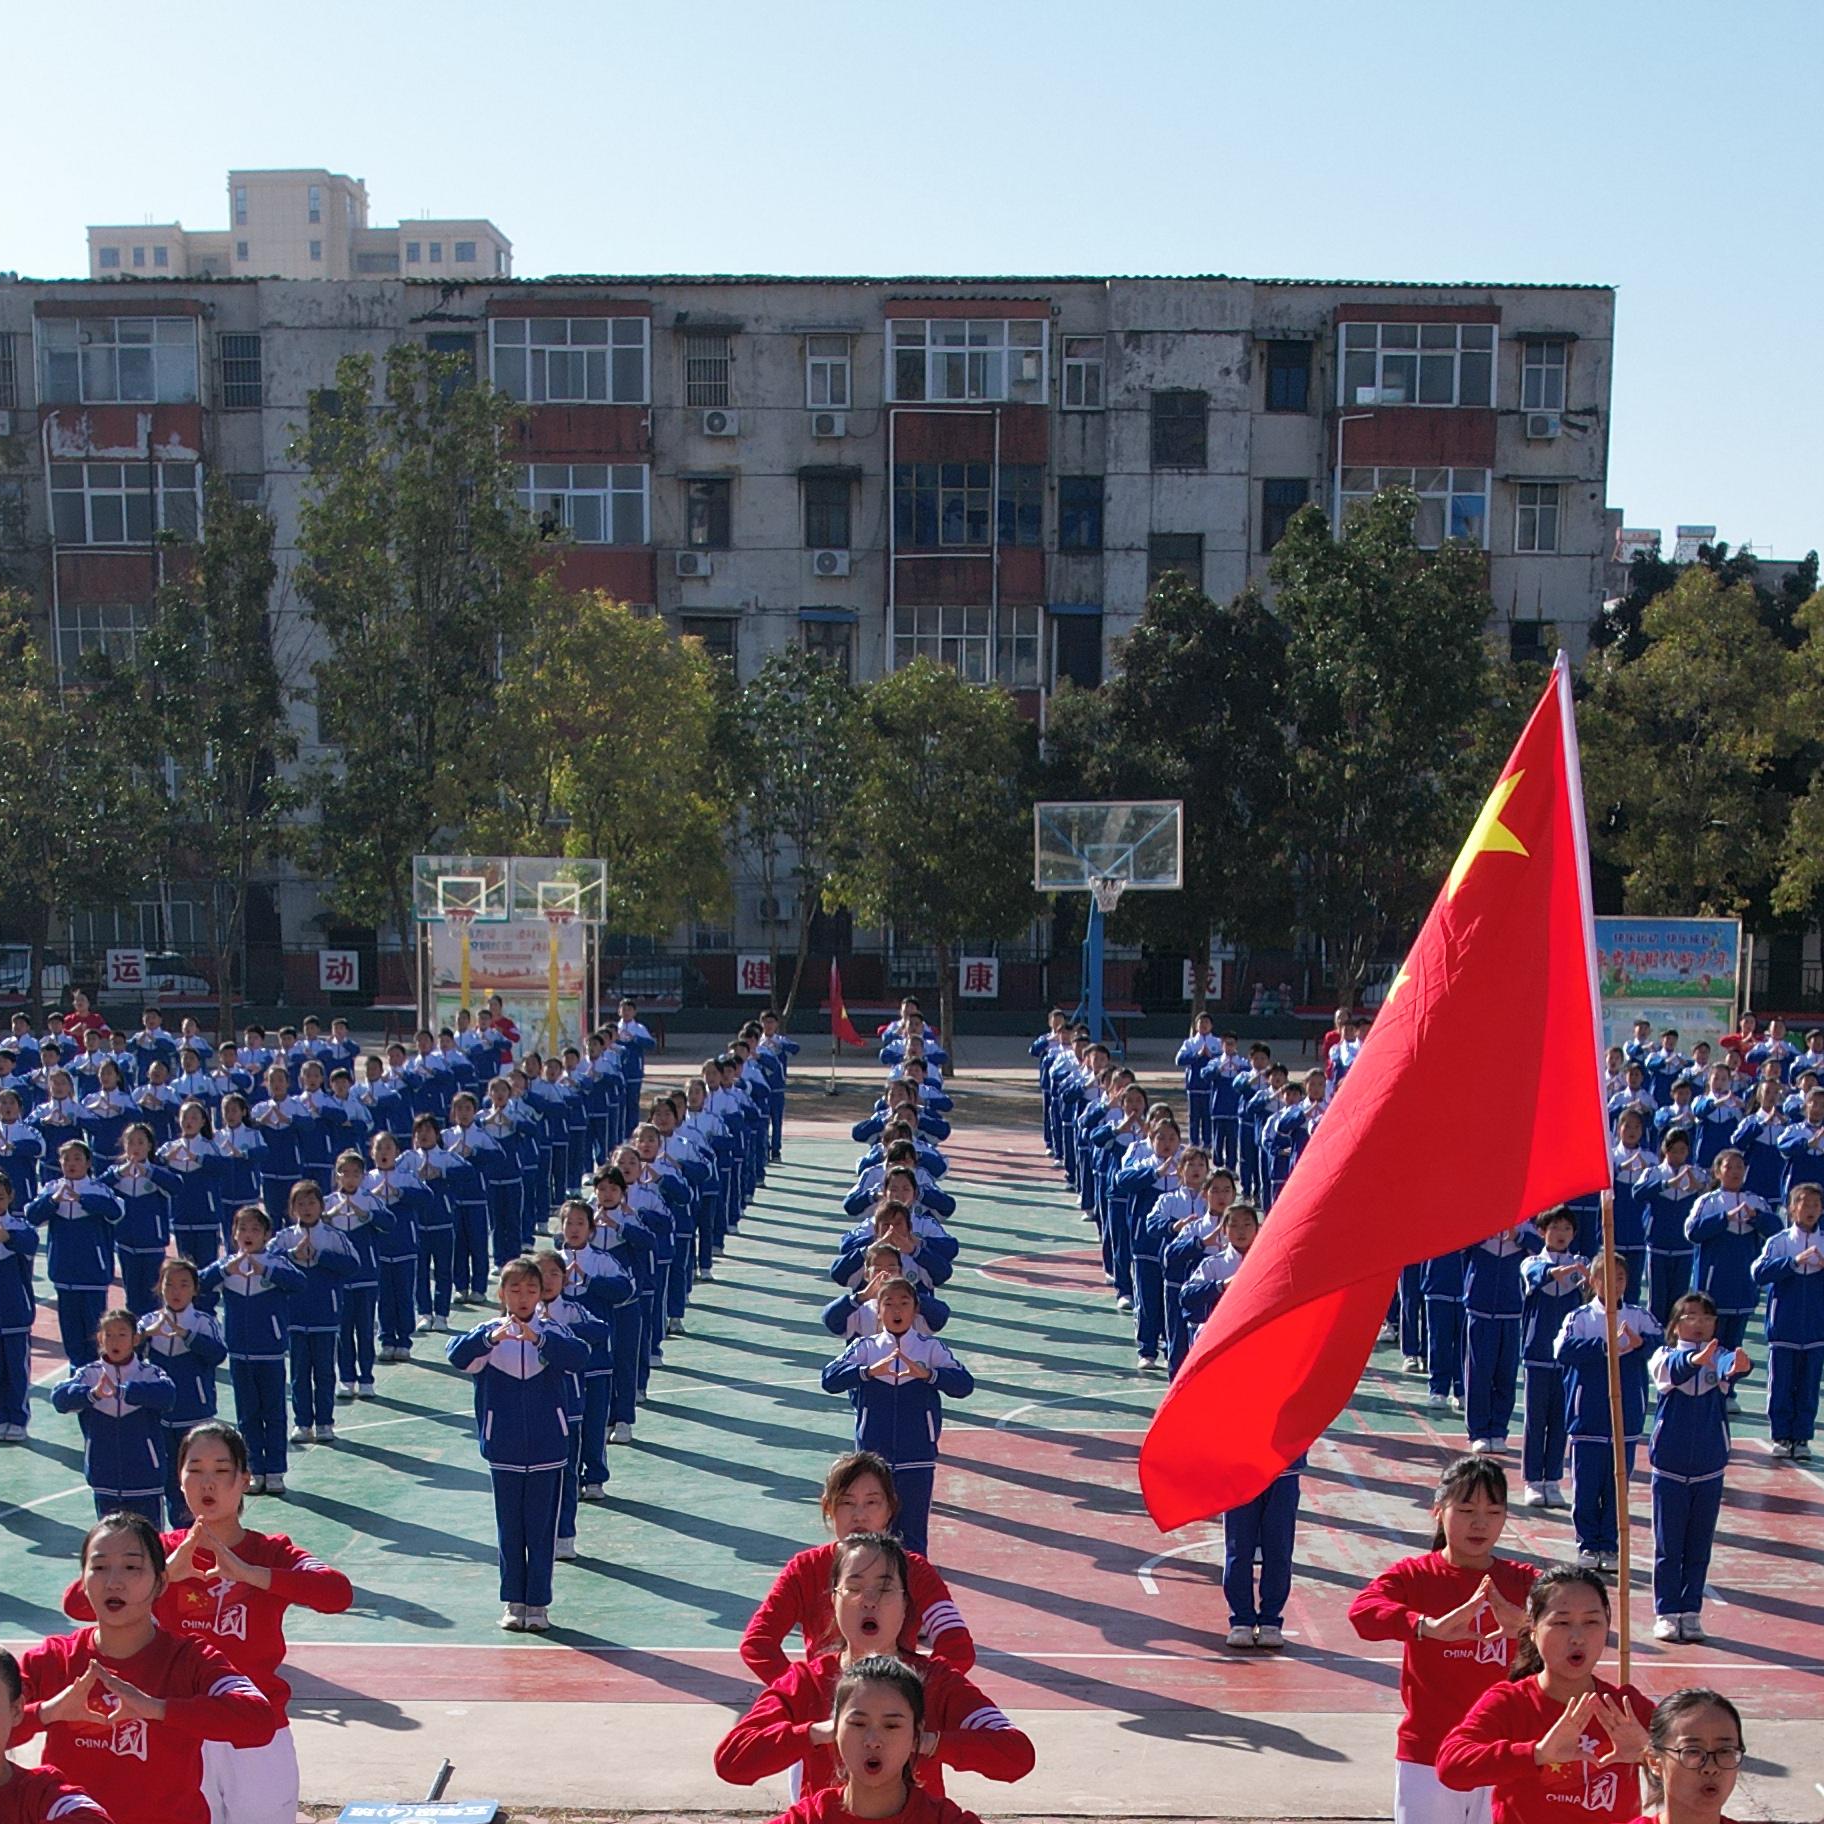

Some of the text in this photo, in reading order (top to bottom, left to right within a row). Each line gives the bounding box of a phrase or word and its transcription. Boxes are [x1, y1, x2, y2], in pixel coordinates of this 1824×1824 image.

[112, 954, 143, 983] 运
[325, 956, 355, 985] 动
[964, 963, 994, 992] 康
[181, 1620, 212, 1630] CHINA
[1443, 1649, 1474, 1659] CHINA
[75, 1738, 110, 1749] CHINA
[1545, 1793, 1581, 1804] CHINA
